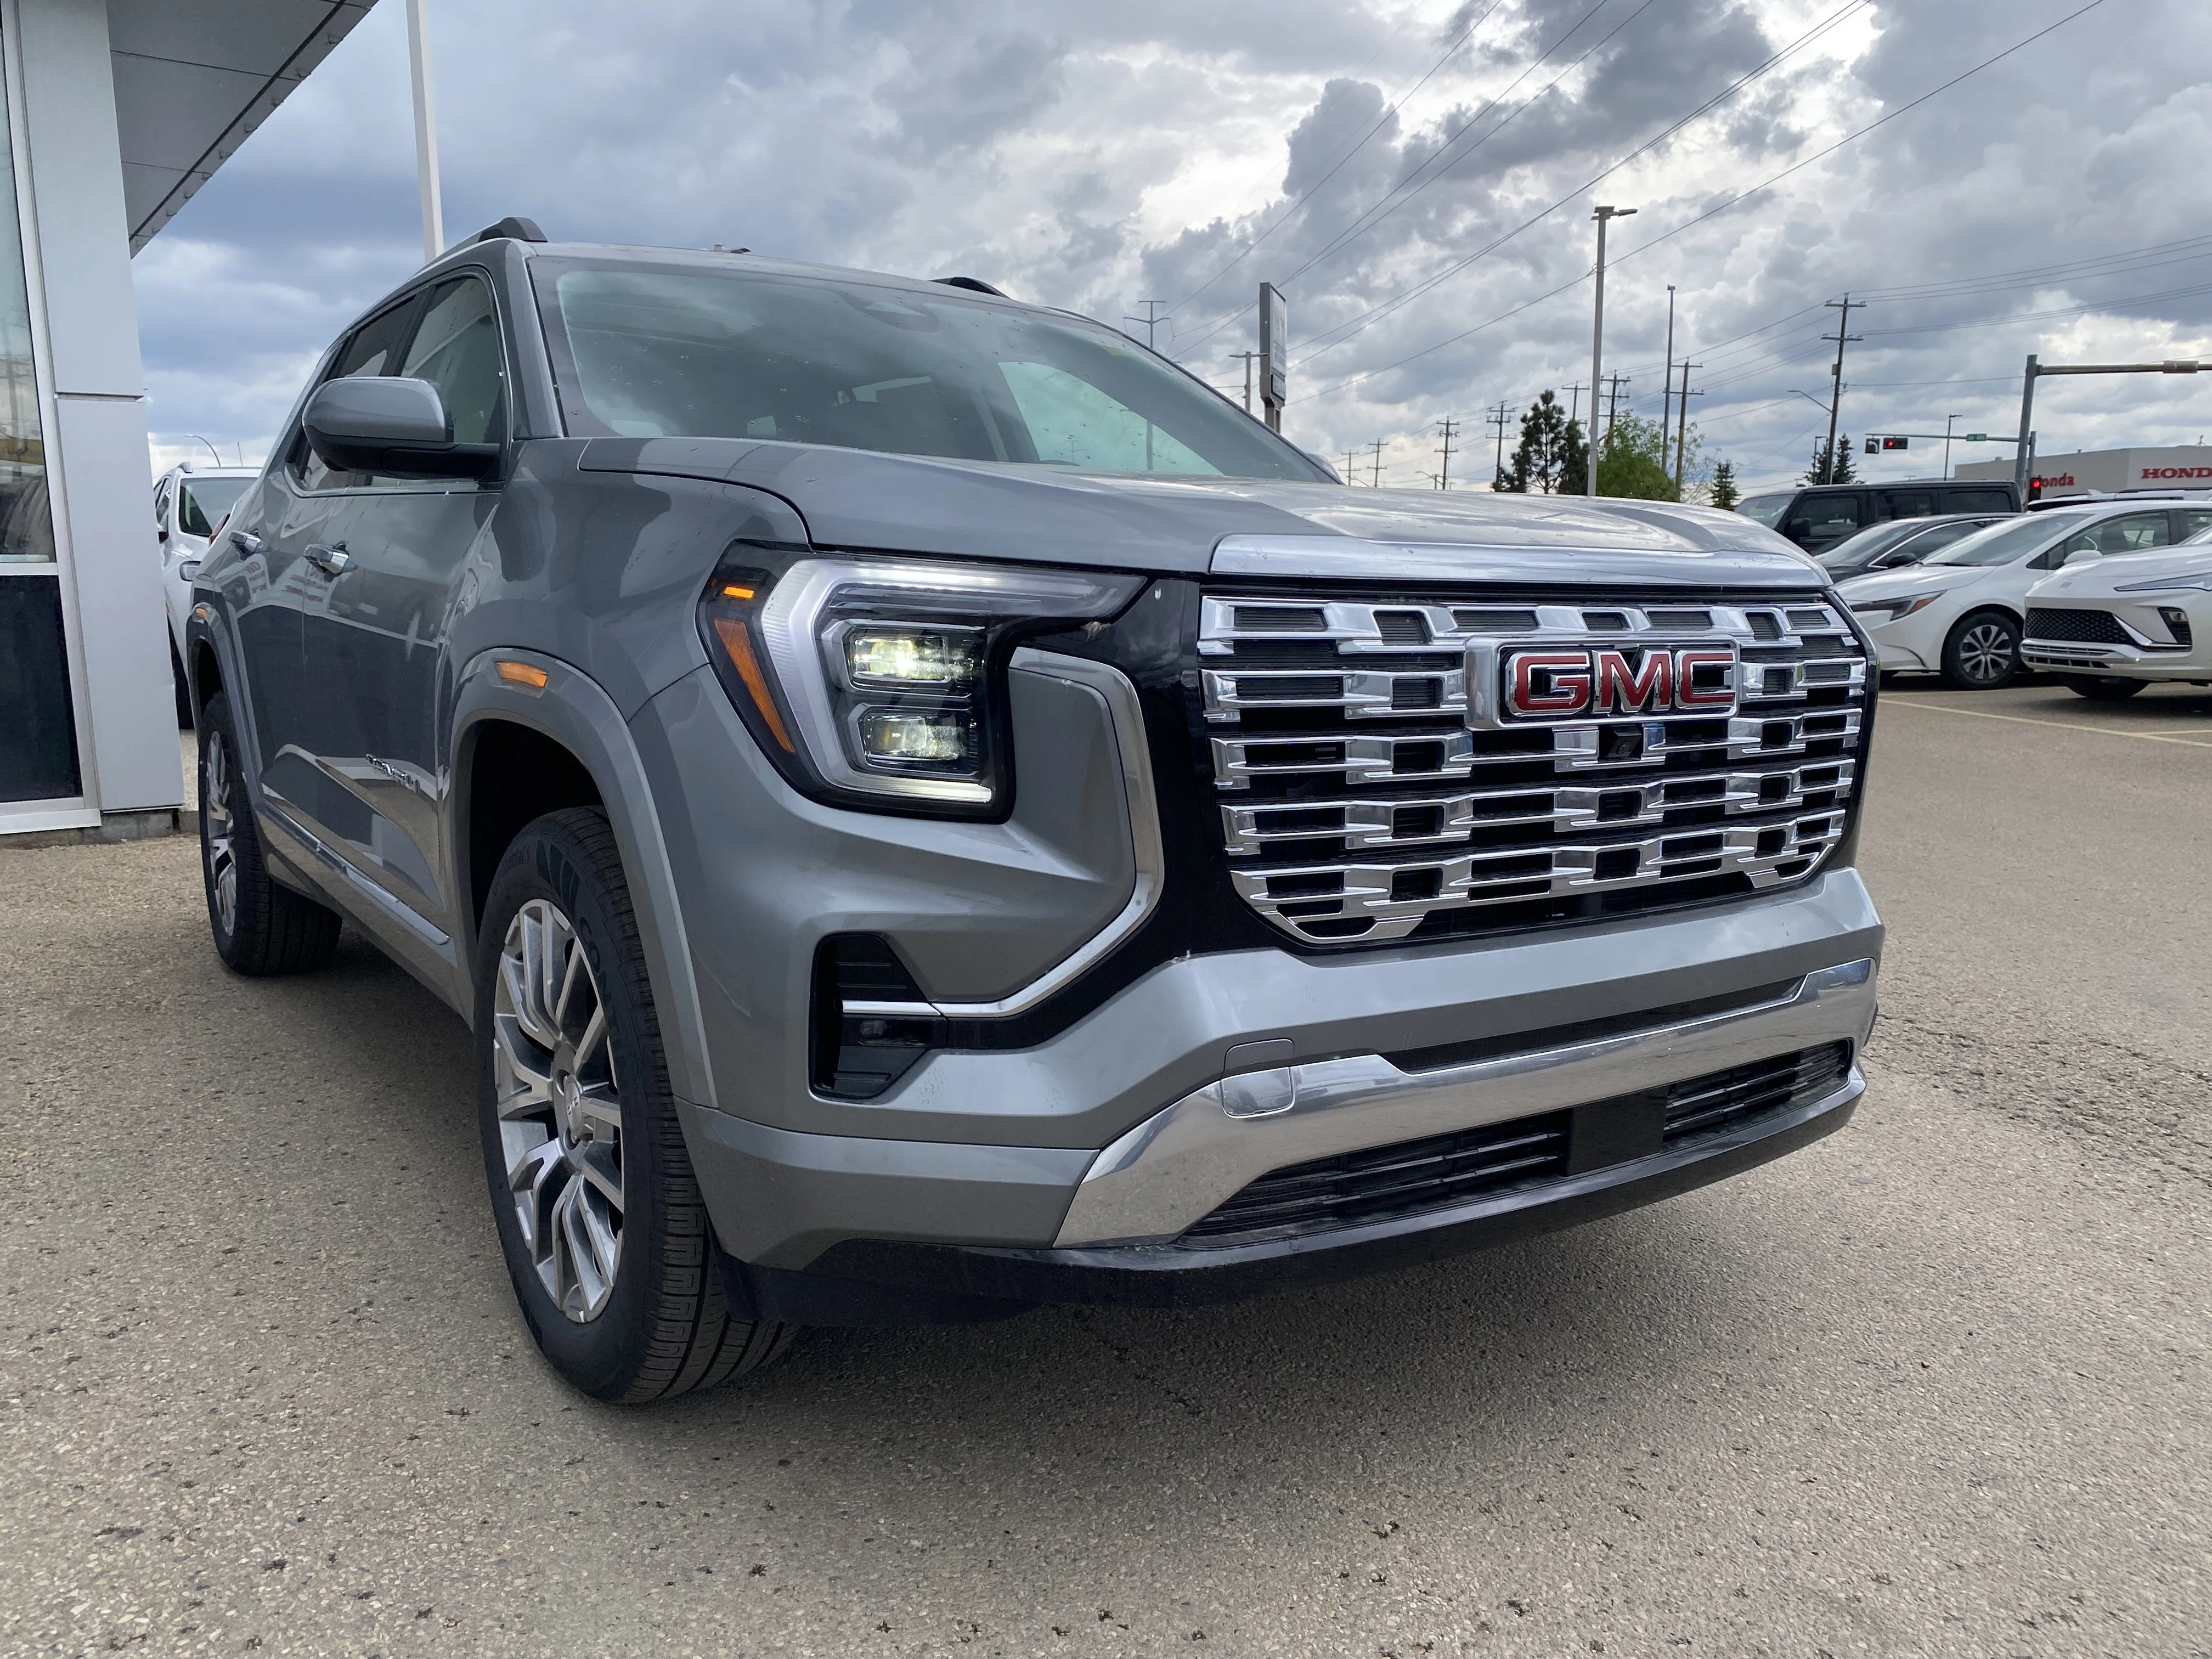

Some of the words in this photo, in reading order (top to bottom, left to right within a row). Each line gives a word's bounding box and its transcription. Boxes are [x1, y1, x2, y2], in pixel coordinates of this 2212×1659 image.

[2038, 472, 2075, 487] onda
[2141, 467, 2212, 479] HOND
[1505, 649, 1736, 716] GMC
